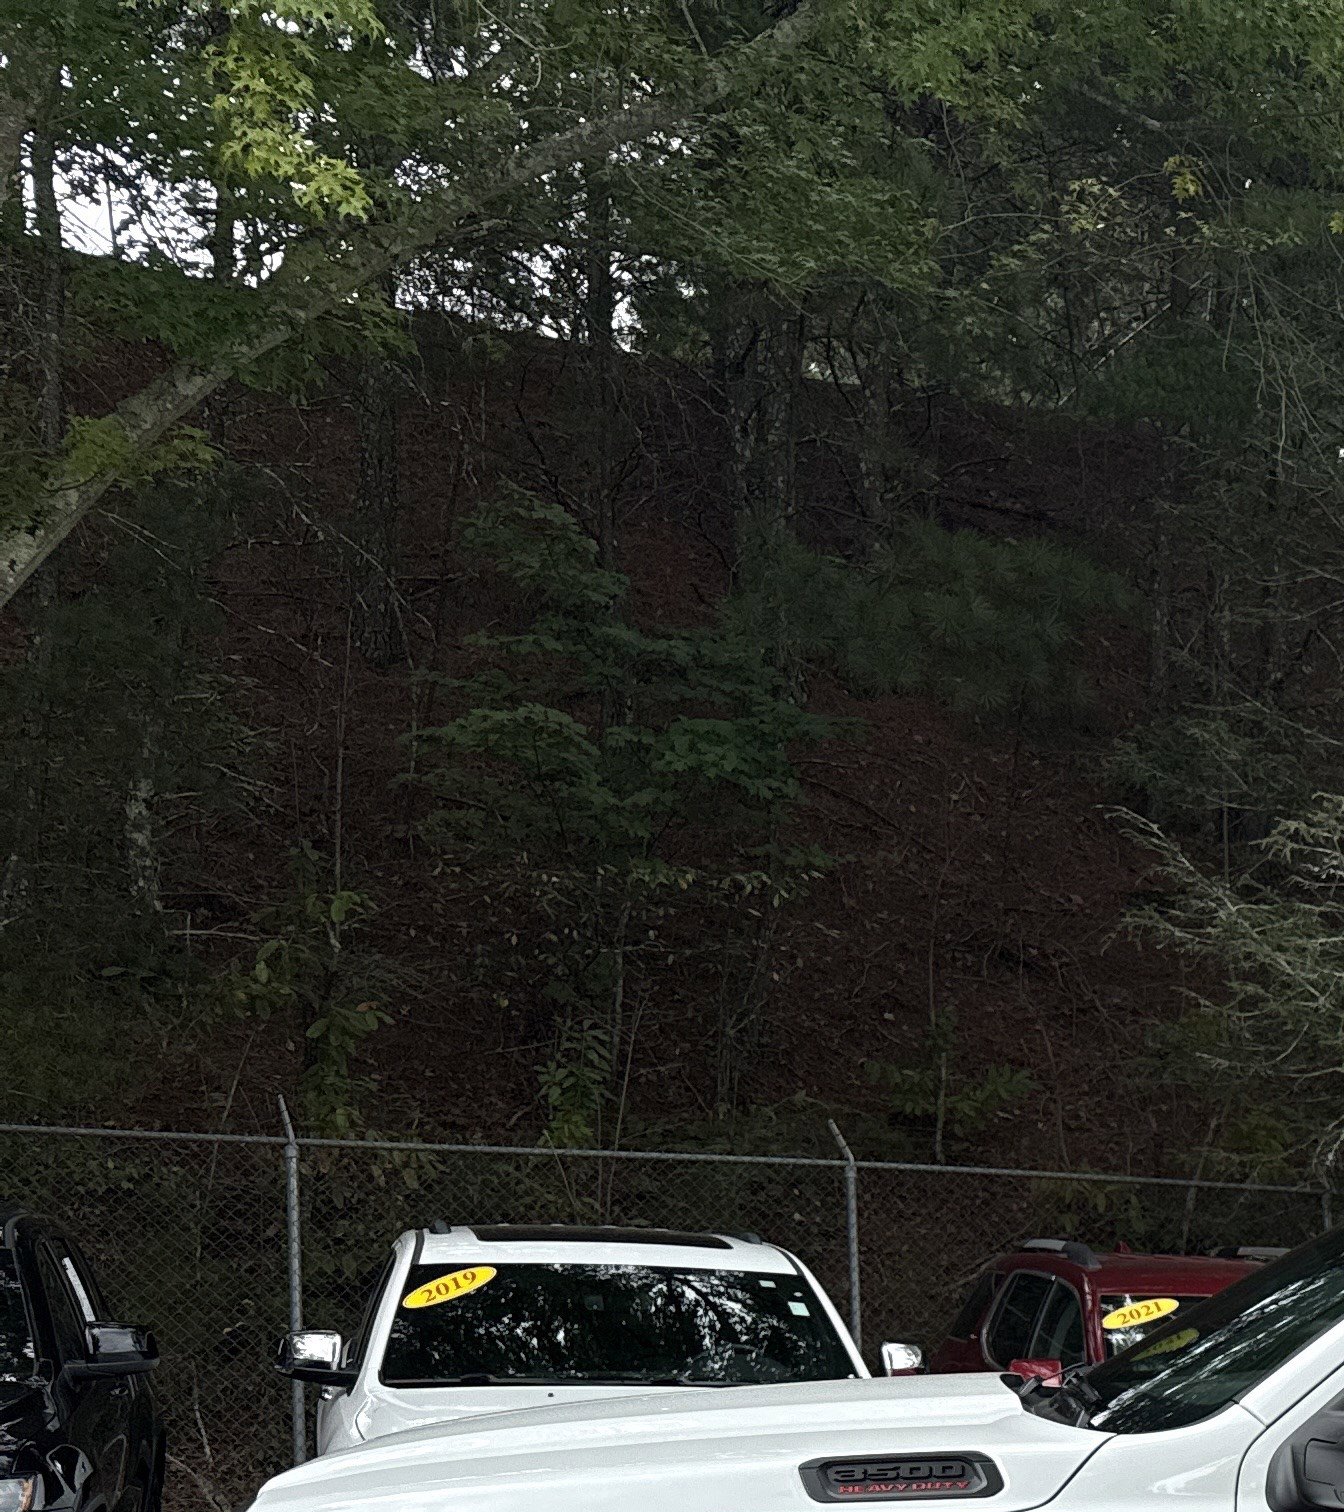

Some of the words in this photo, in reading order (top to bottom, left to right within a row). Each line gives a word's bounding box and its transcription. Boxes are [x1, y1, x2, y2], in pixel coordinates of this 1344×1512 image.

[420, 1271, 477, 1303] 2019
[1116, 1301, 1162, 1325] 2021
[833, 1464, 965, 1483] 3500
[838, 1483, 909, 1495] HEAVY
[911, 1480, 972, 1491] DUTY
